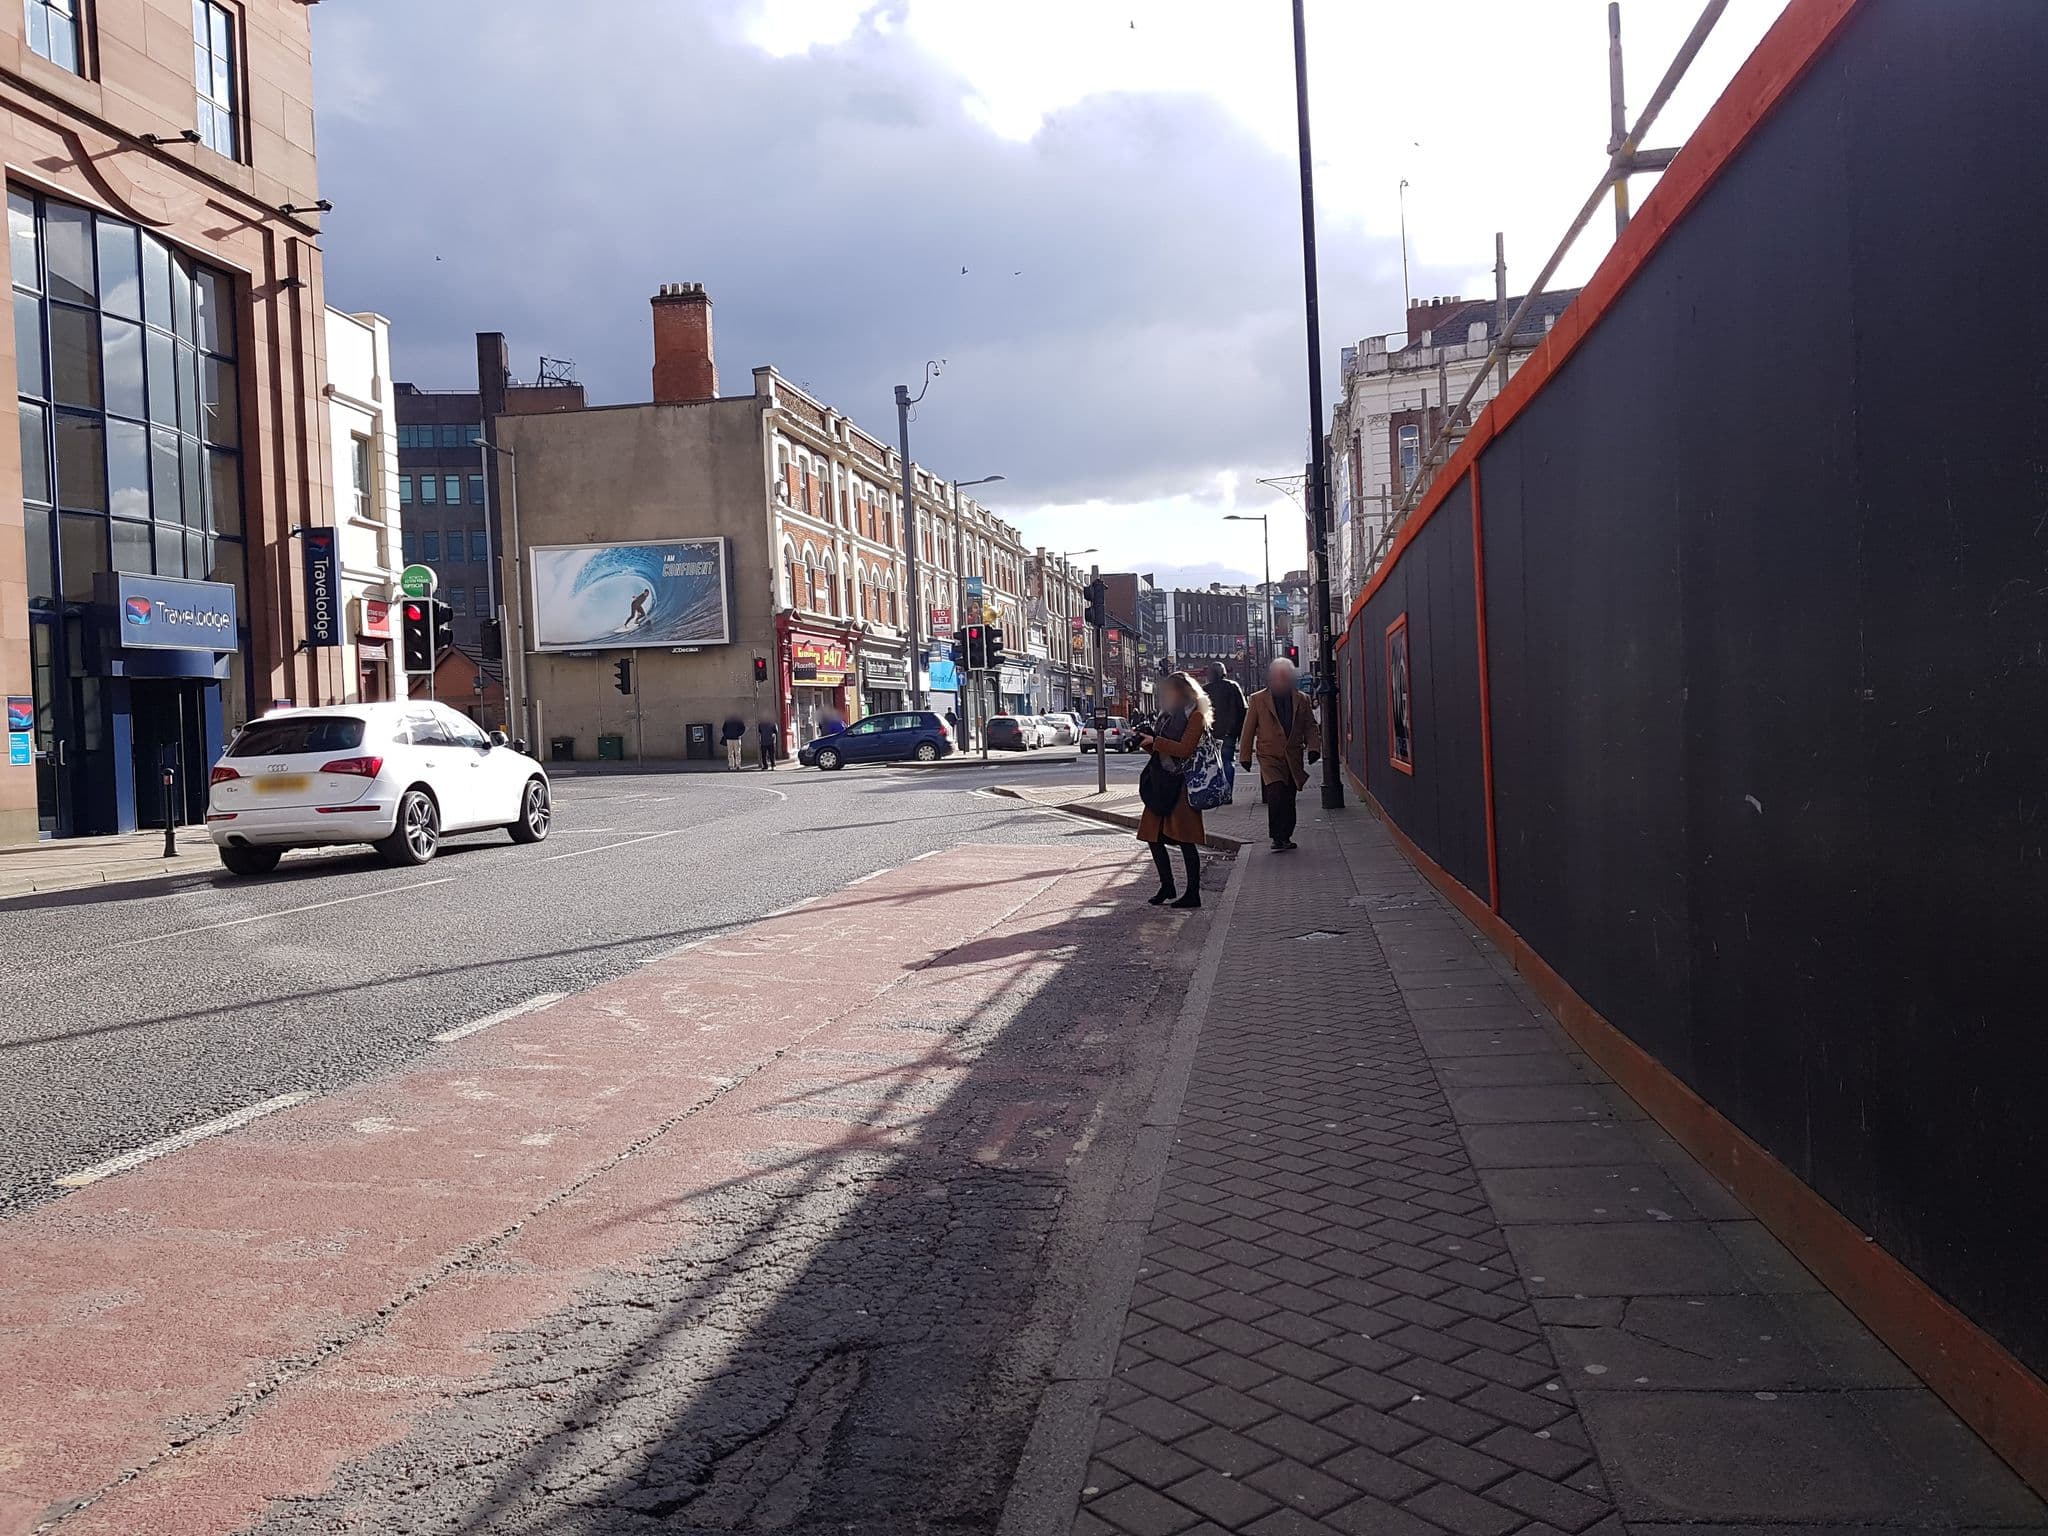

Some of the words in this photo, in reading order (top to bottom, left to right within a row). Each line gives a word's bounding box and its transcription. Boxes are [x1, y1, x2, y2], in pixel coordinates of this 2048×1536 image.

[667, 554, 676, 562] AM
[662, 561, 715, 577] CONFIDENT
[313, 556, 332, 640] Travelodge
[155, 600, 231, 632] Travelodge
[823, 649, 842, 669] 24/7
